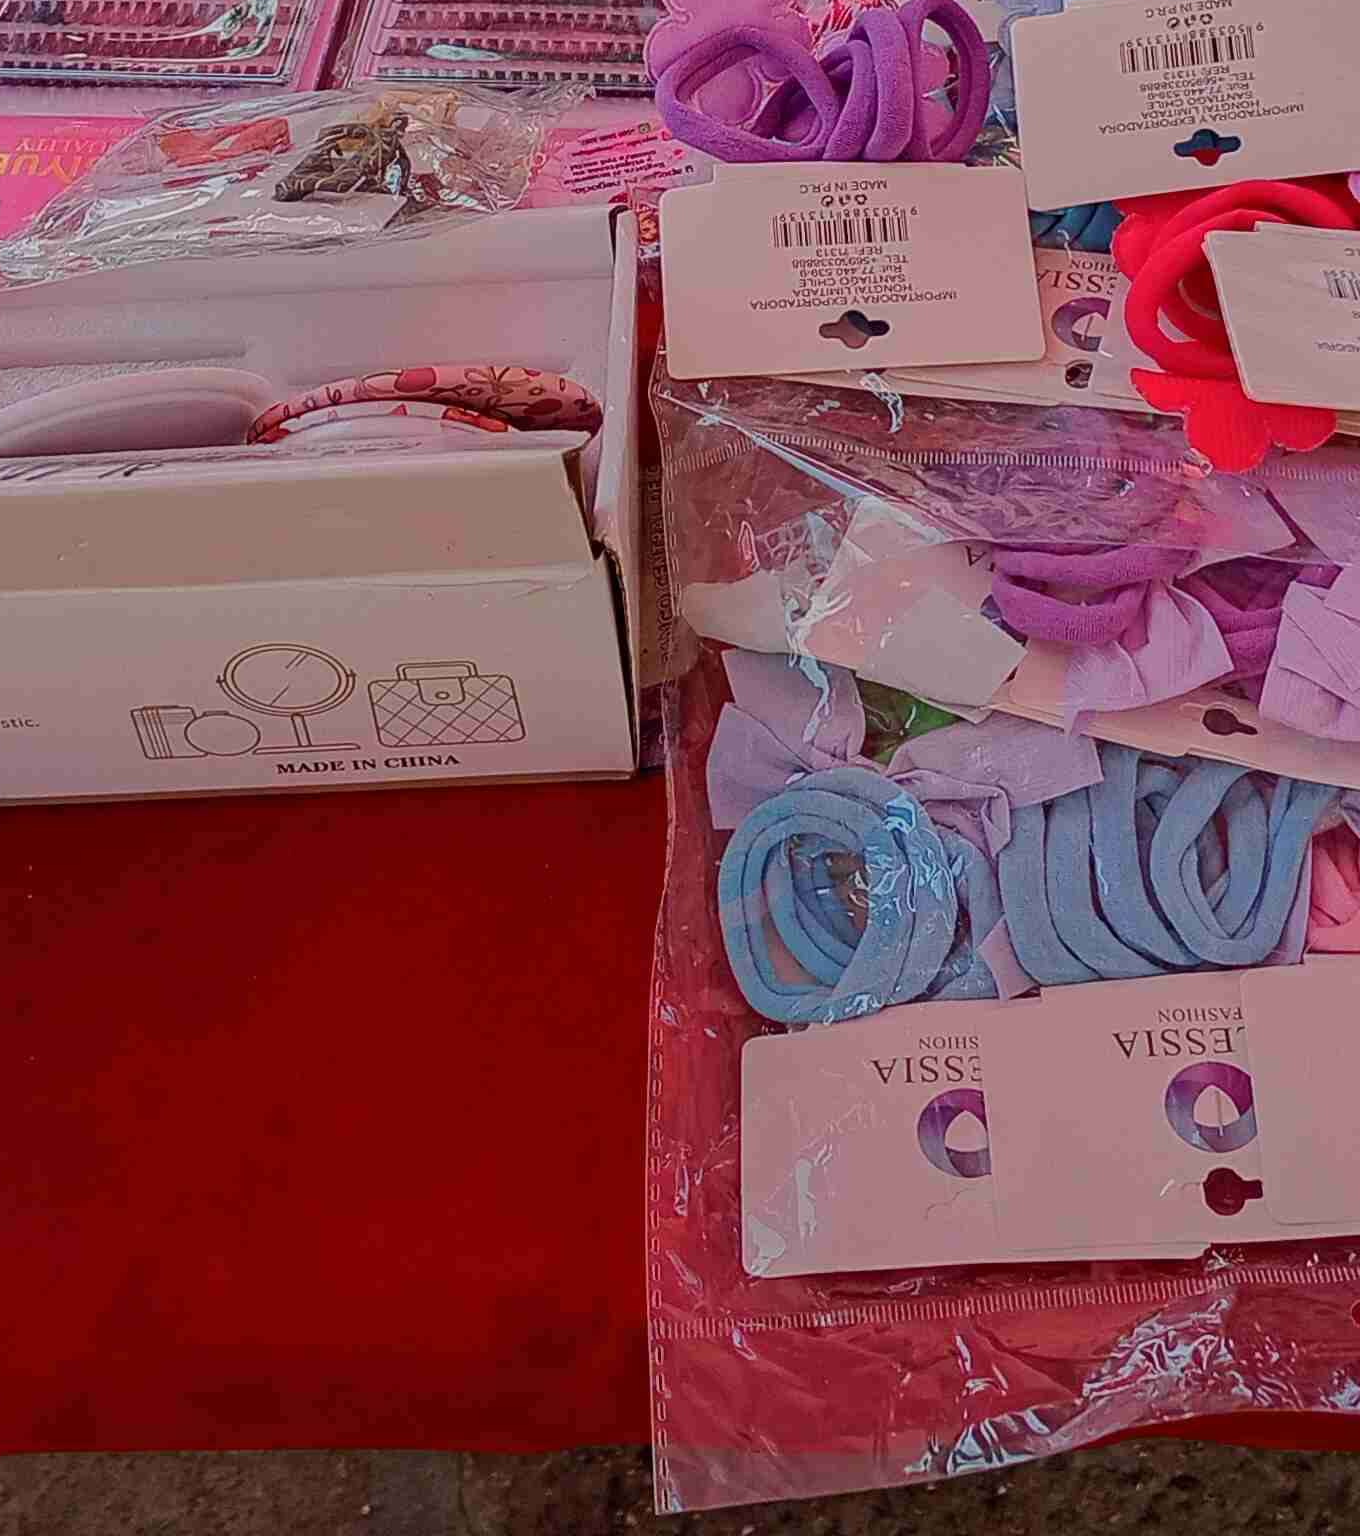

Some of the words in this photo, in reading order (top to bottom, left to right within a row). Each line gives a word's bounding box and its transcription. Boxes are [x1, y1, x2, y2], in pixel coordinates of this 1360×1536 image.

[1180, 1, 1193, 13] IN
[1146, 98, 1183, 111] CHILE
[1186, 91, 1252, 106] SANTIAGO
[1209, 103, 1305, 122] IMPORTADORA
[1097, 114, 1196, 135] EXPORTADORA
[834, 182, 847, 193] IN
[850, 180, 888, 192] MADE
[799, 277, 837, 289] CHILE
[839, 274, 906, 286] SANTIAGO
[749, 295, 848, 311] EXPORTADORA
[864, 290, 958, 305] IMPORTADORA
[276, 759, 346, 776] MADE
[351, 758, 378, 772] IN
[383, 753, 461, 769] CHINA
[918, 1035, 979, 1053] SHION
[1111, 1024, 1244, 1061] ESSIA
[869, 1054, 980, 1085] ESSIA
